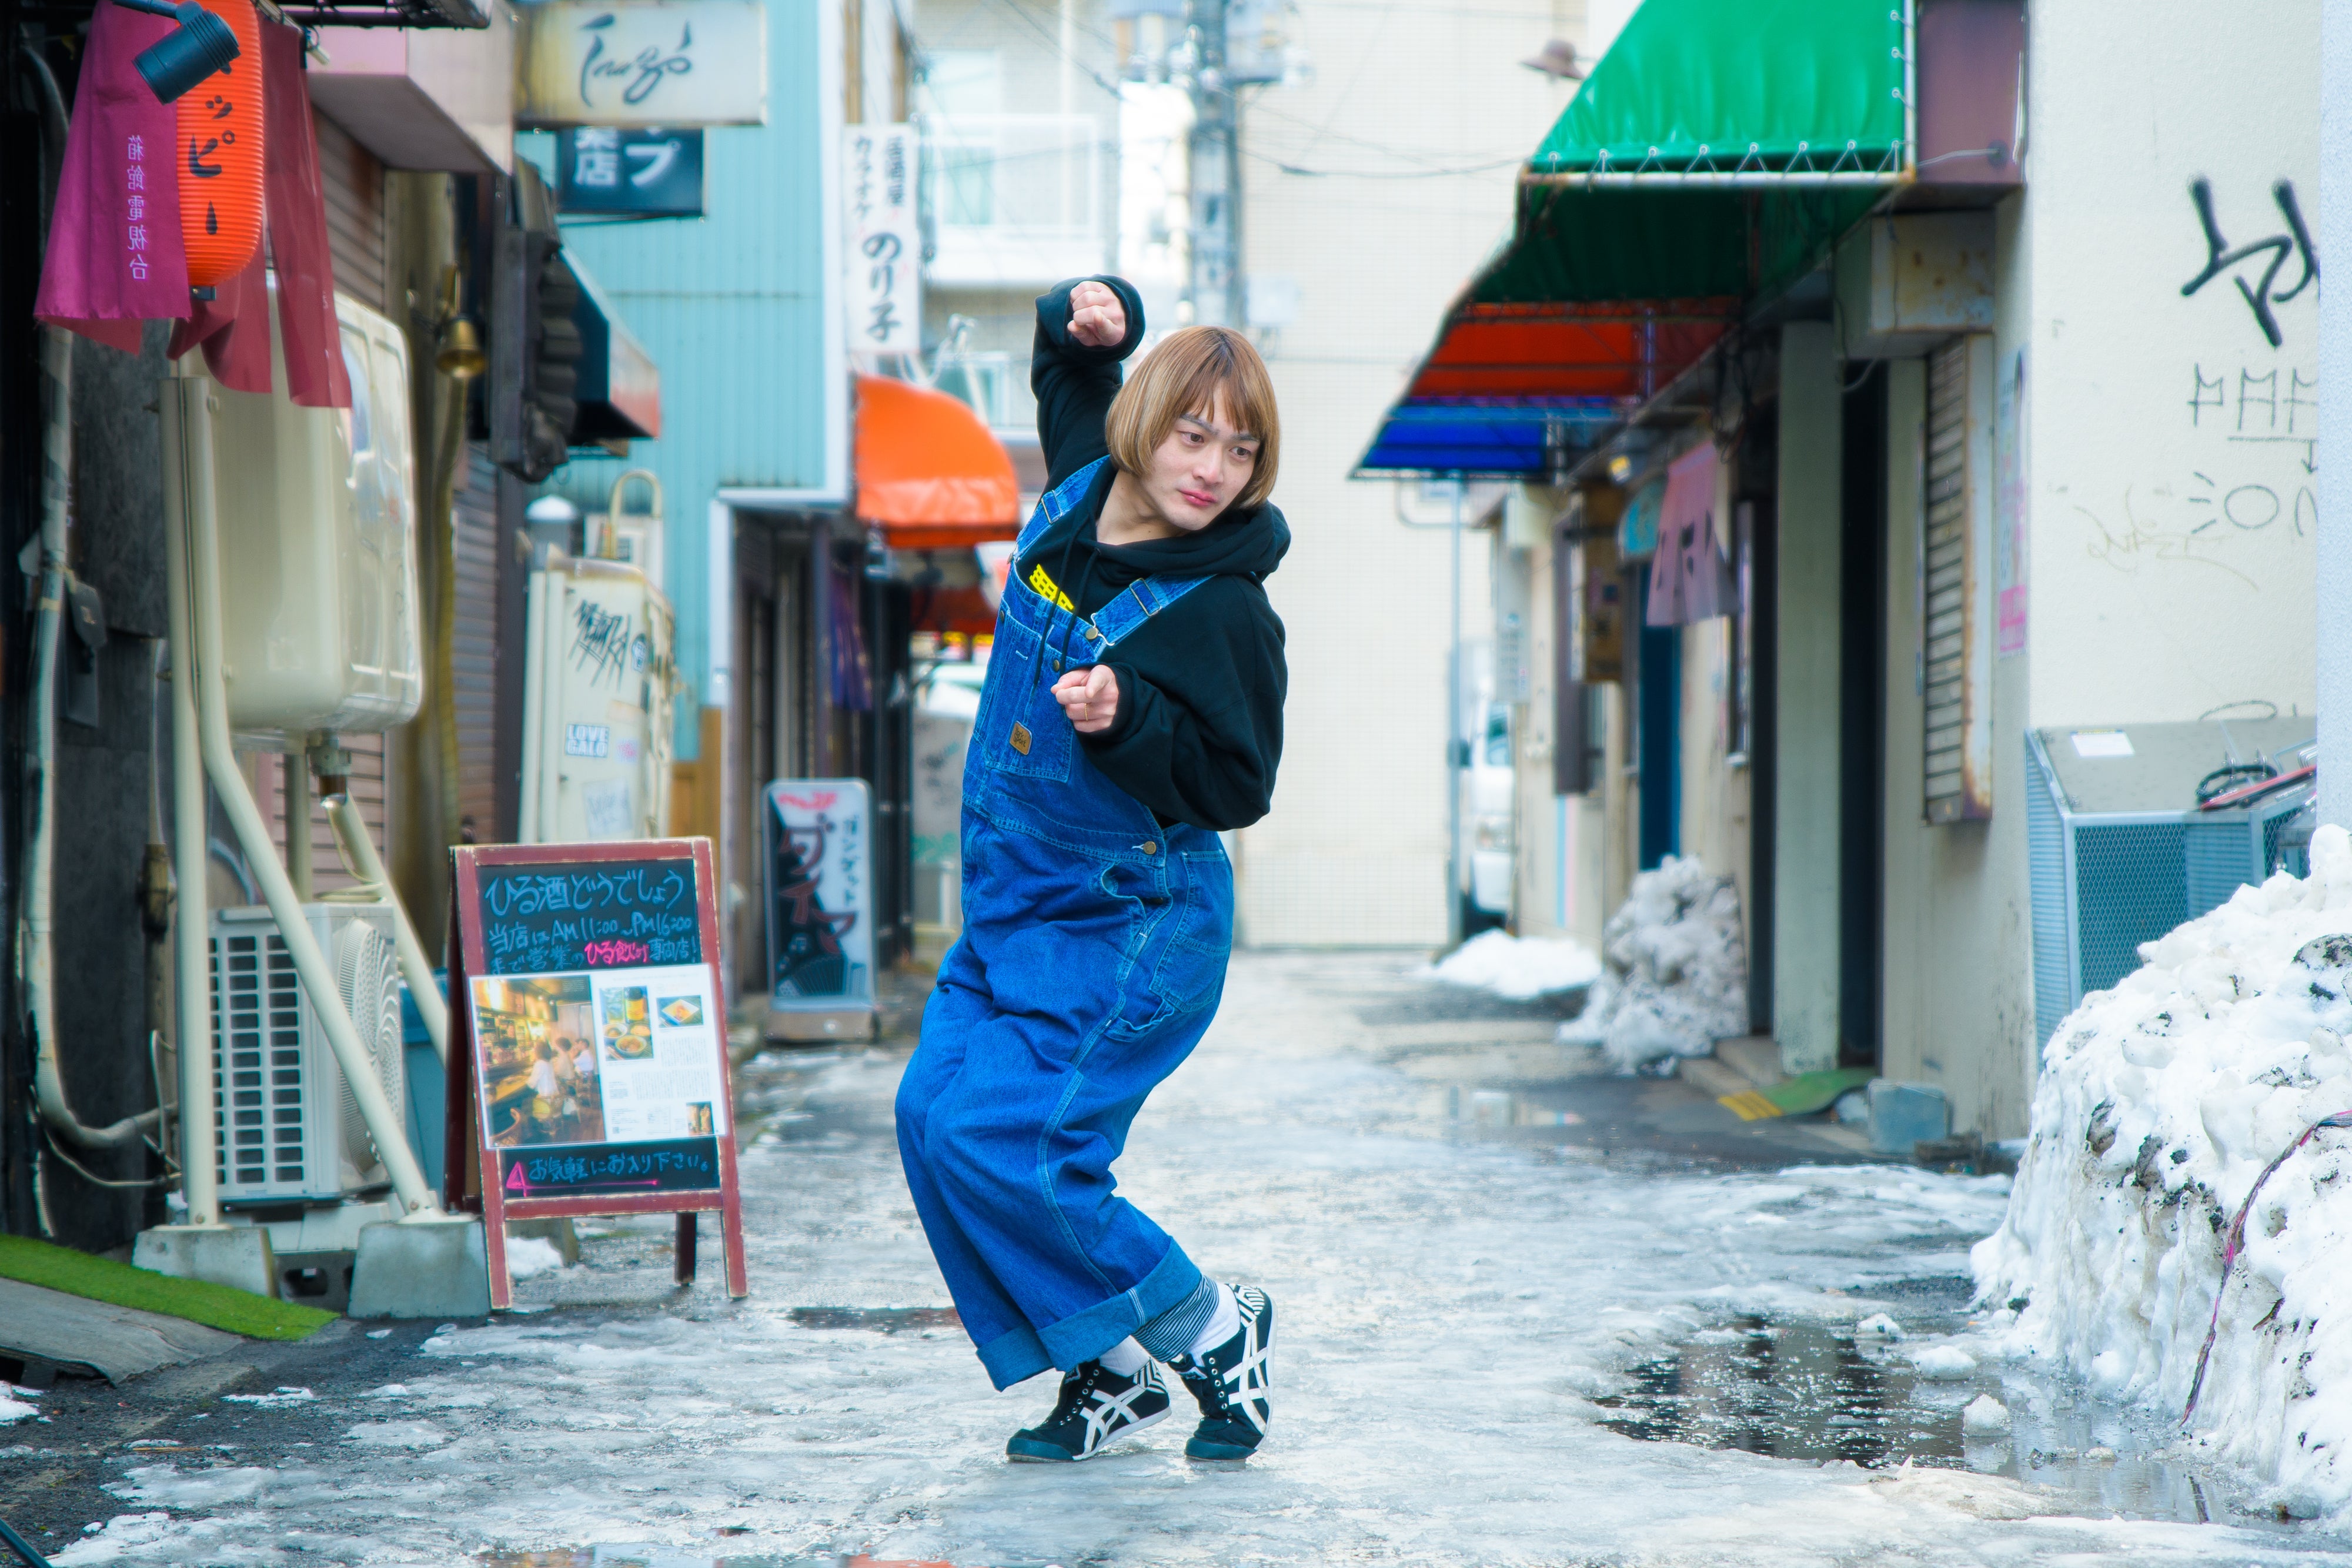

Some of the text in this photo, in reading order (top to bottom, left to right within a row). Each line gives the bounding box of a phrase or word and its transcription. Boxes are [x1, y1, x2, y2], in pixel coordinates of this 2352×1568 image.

[188, 66, 236, 235] ッピー
[626, 126, 682, 187] プ
[861, 231, 903, 343] のり子
[568, 724, 609, 743] LOVE
[485, 868, 685, 917] ひる酒どうでしょう
